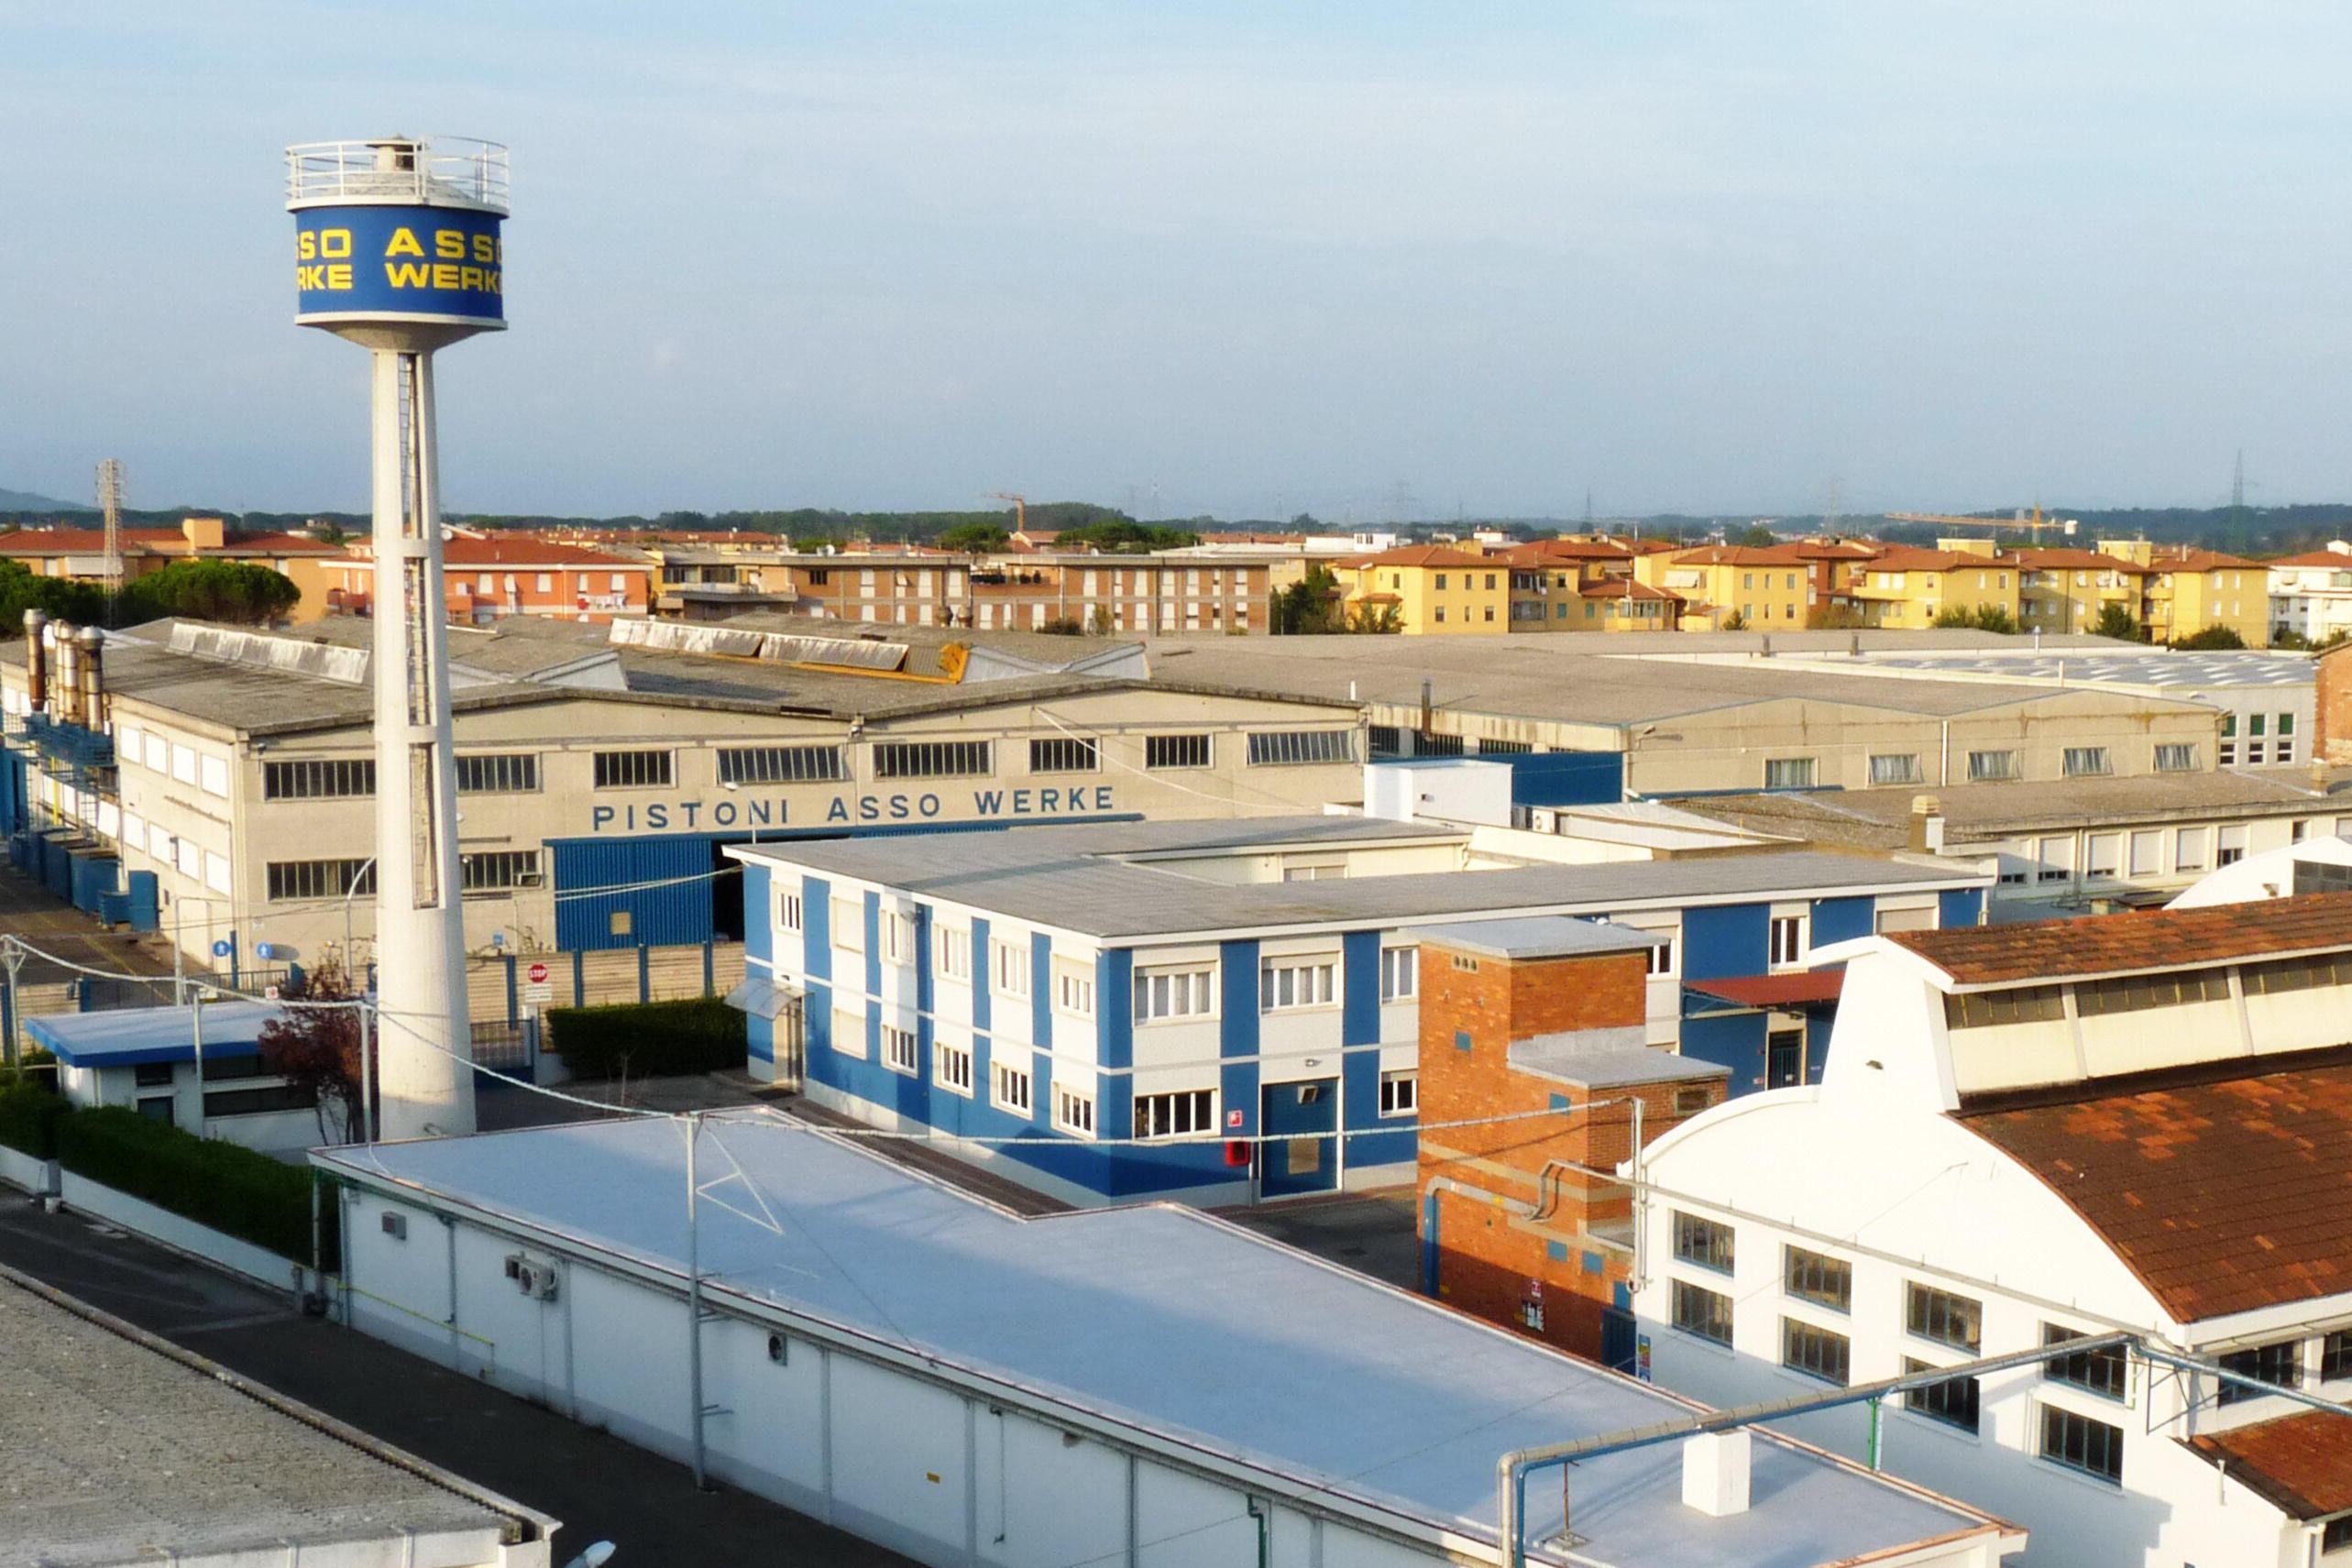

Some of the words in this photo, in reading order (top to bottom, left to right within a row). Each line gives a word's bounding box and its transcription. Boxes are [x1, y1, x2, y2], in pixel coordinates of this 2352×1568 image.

[295, 228, 351, 260] SO
[384, 262, 502, 294] WERK
[593, 799, 787, 831] PISTONI
[827, 794, 940, 821] ASSO
[974, 786, 1114, 815] WERKE
[529, 969, 547, 978] STOP
